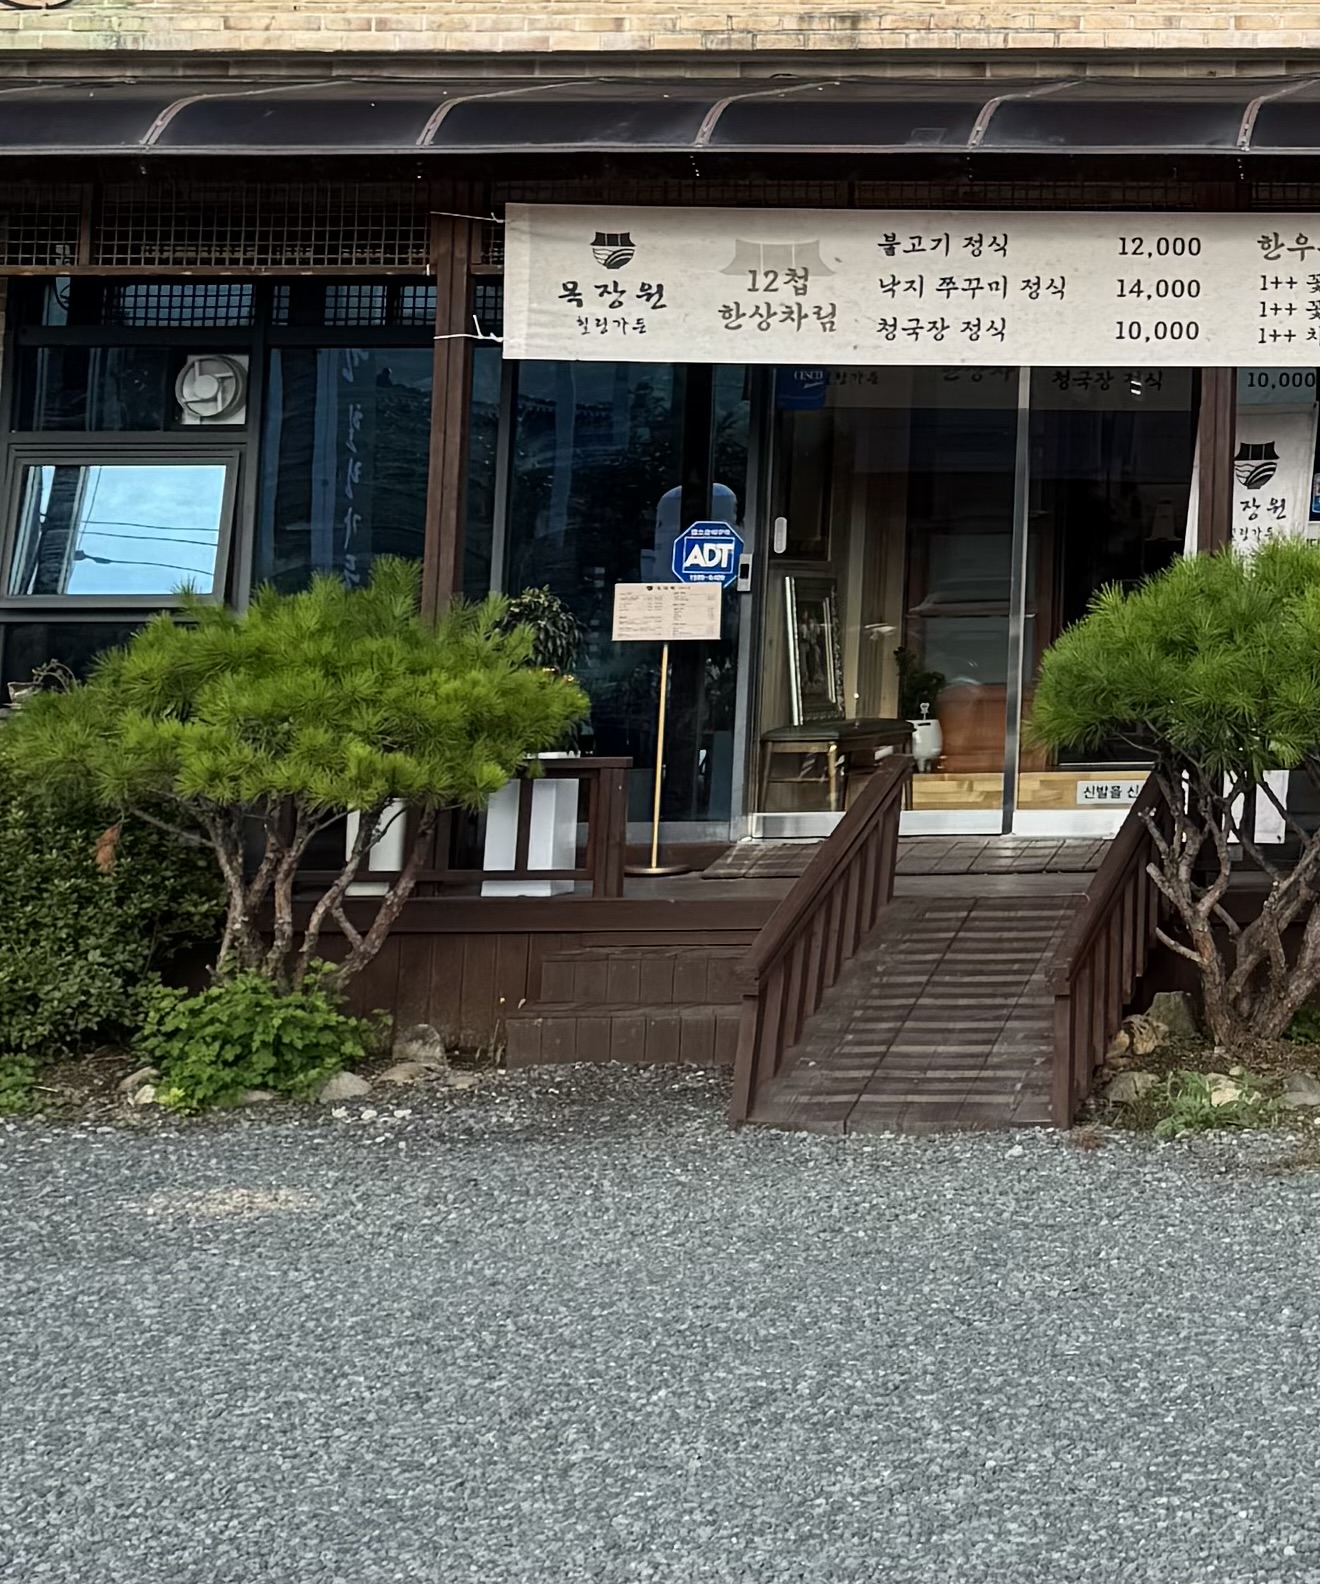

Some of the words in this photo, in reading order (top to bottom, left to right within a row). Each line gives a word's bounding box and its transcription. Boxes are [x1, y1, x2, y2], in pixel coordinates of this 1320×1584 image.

[877, 232, 950, 257] 불고기
[962, 233, 1009, 257] 정식
[1118, 236, 1201, 259] 12,000
[747, 267, 810, 297] 12첩
[878, 274, 924, 298] 낙지
[935, 275, 1008, 299] 쭈꾸미
[1020, 275, 1066, 300] 정식
[1116, 278, 1201, 300] 14,000
[1259, 275, 1298, 291] 1++
[559, 280, 668, 310] 목장원
[718, 301, 838, 333] 한상차림
[1259, 301, 1297, 317] 1++
[576, 316, 647, 335] 힐링가든
[876, 317, 950, 341] 청국장
[960, 317, 1006, 342] 정식
[1115, 320, 1200, 342] 10,000
[1257, 327, 1297, 344] 1++
[1053, 371, 1114, 391] 청국장
[1248, 372, 1316, 389] 10,000
[1240, 497, 1286, 520] 장원
[684, 543, 735, 568] ADT
[1083, 786, 1122, 799] 신발을
